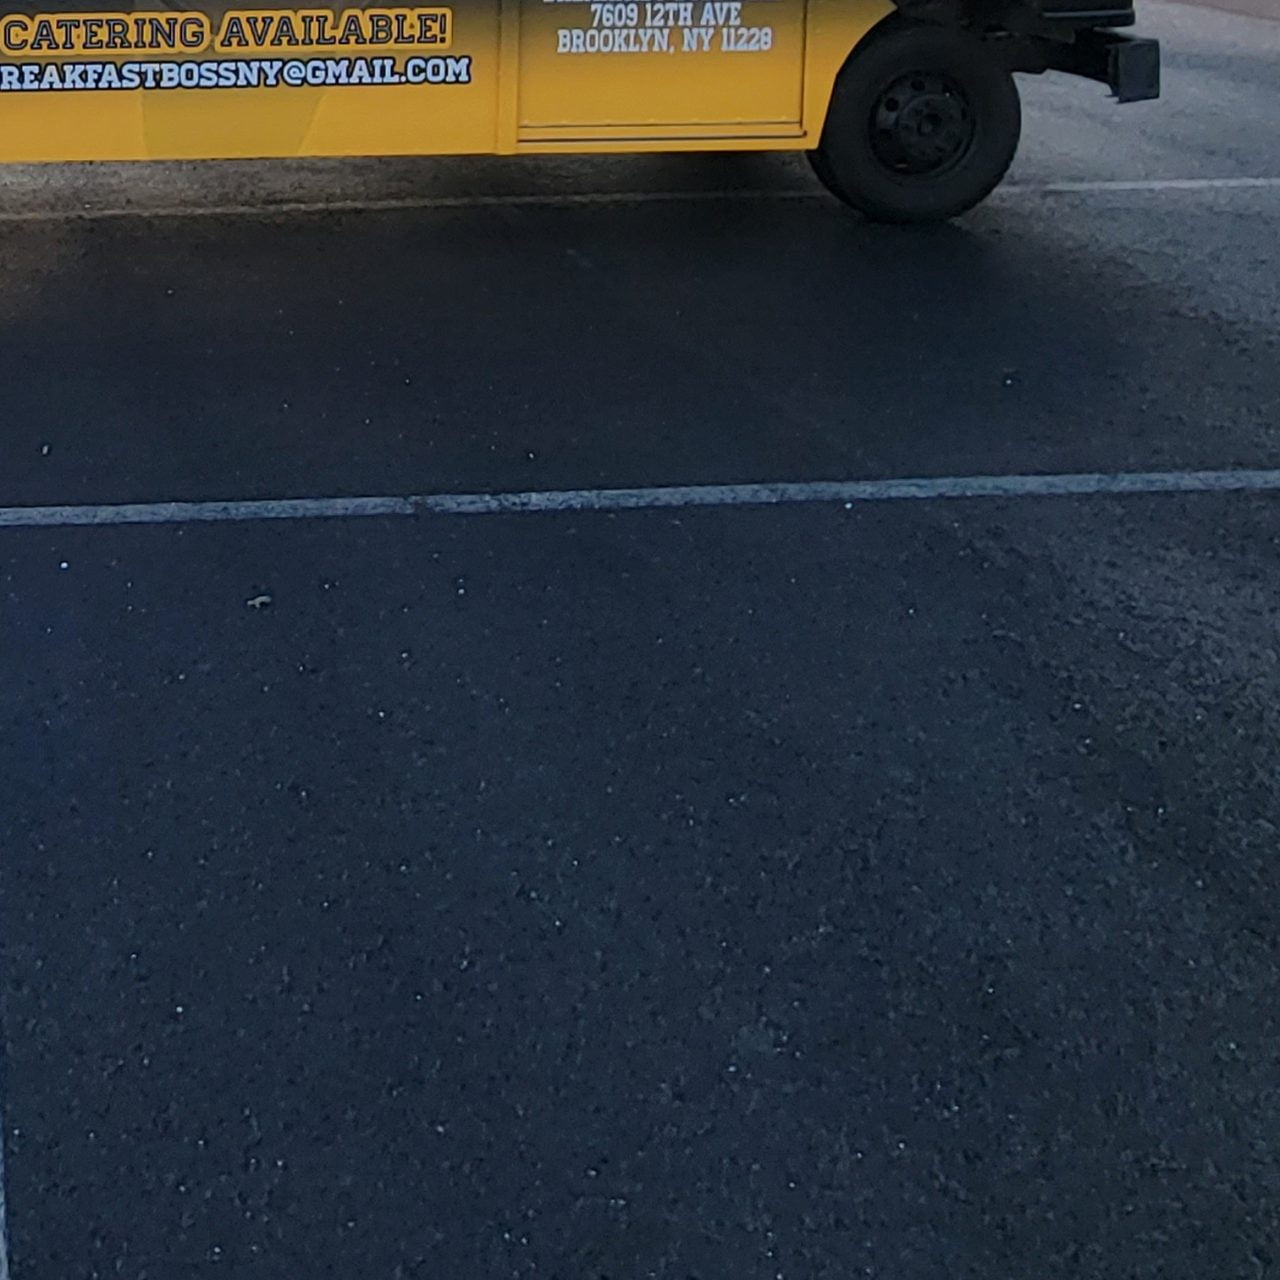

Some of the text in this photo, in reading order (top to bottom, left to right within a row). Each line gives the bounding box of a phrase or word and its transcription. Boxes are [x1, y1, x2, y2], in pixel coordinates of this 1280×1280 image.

[590, 1, 742, 28] 7609 12TH AVE
[3, 12, 448, 51] CATERING AVAILABLE!
[556, 26, 773, 54] BROOKLYN, NY 11228
